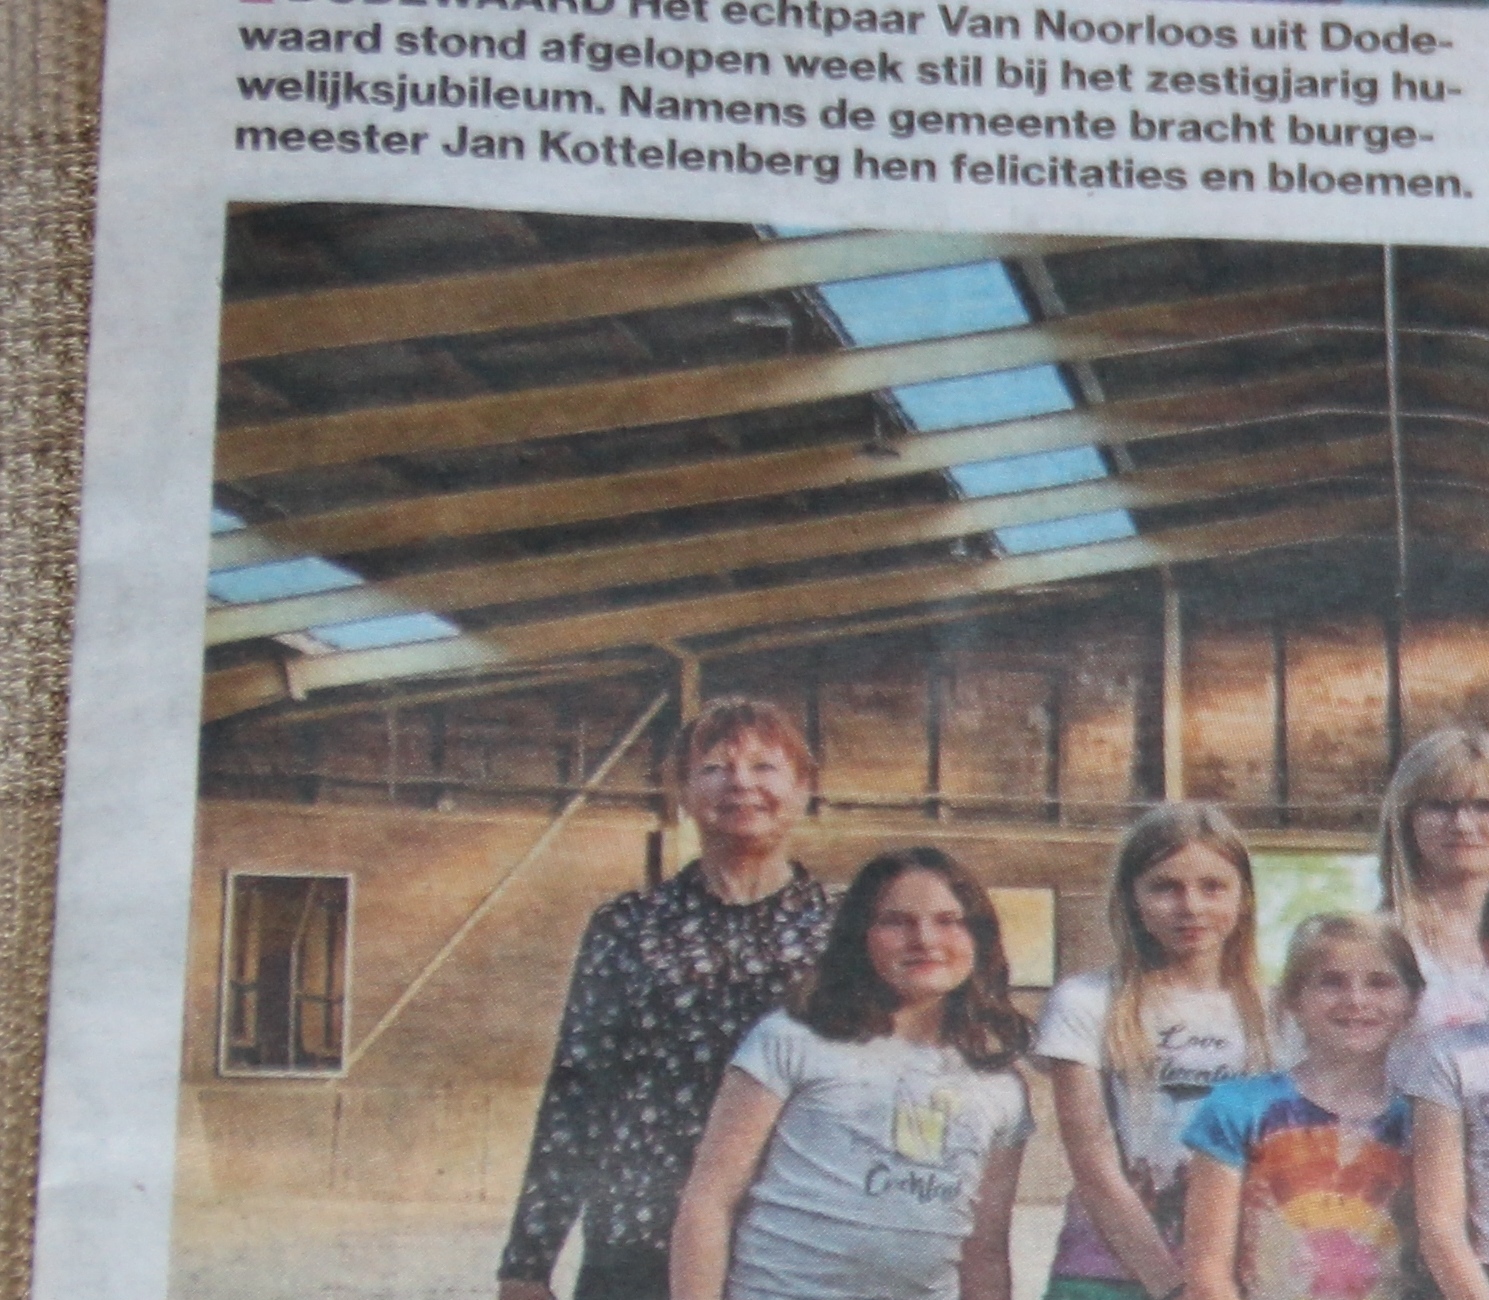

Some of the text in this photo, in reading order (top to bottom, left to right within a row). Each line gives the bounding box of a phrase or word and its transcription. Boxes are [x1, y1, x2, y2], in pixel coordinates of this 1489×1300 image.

[239, 22, 1461, 105] waard stond afgelopen week stil bij het zestigjarig hu-
[722, 0, 925, 36] echtpaar
[939, 5, 1020, 38] Van
[1035, 9, 1237, 48] Noorloos
[1252, 20, 1306, 50] uit
[1321, 21, 1452, 54] Dode-
[237, 70, 1433, 153] welijksjubileum. Namens de gemeente bracht burge-
[236, 124, 1472, 197] meester Jan Kottelenberg hen felicitaties en bloemen.
